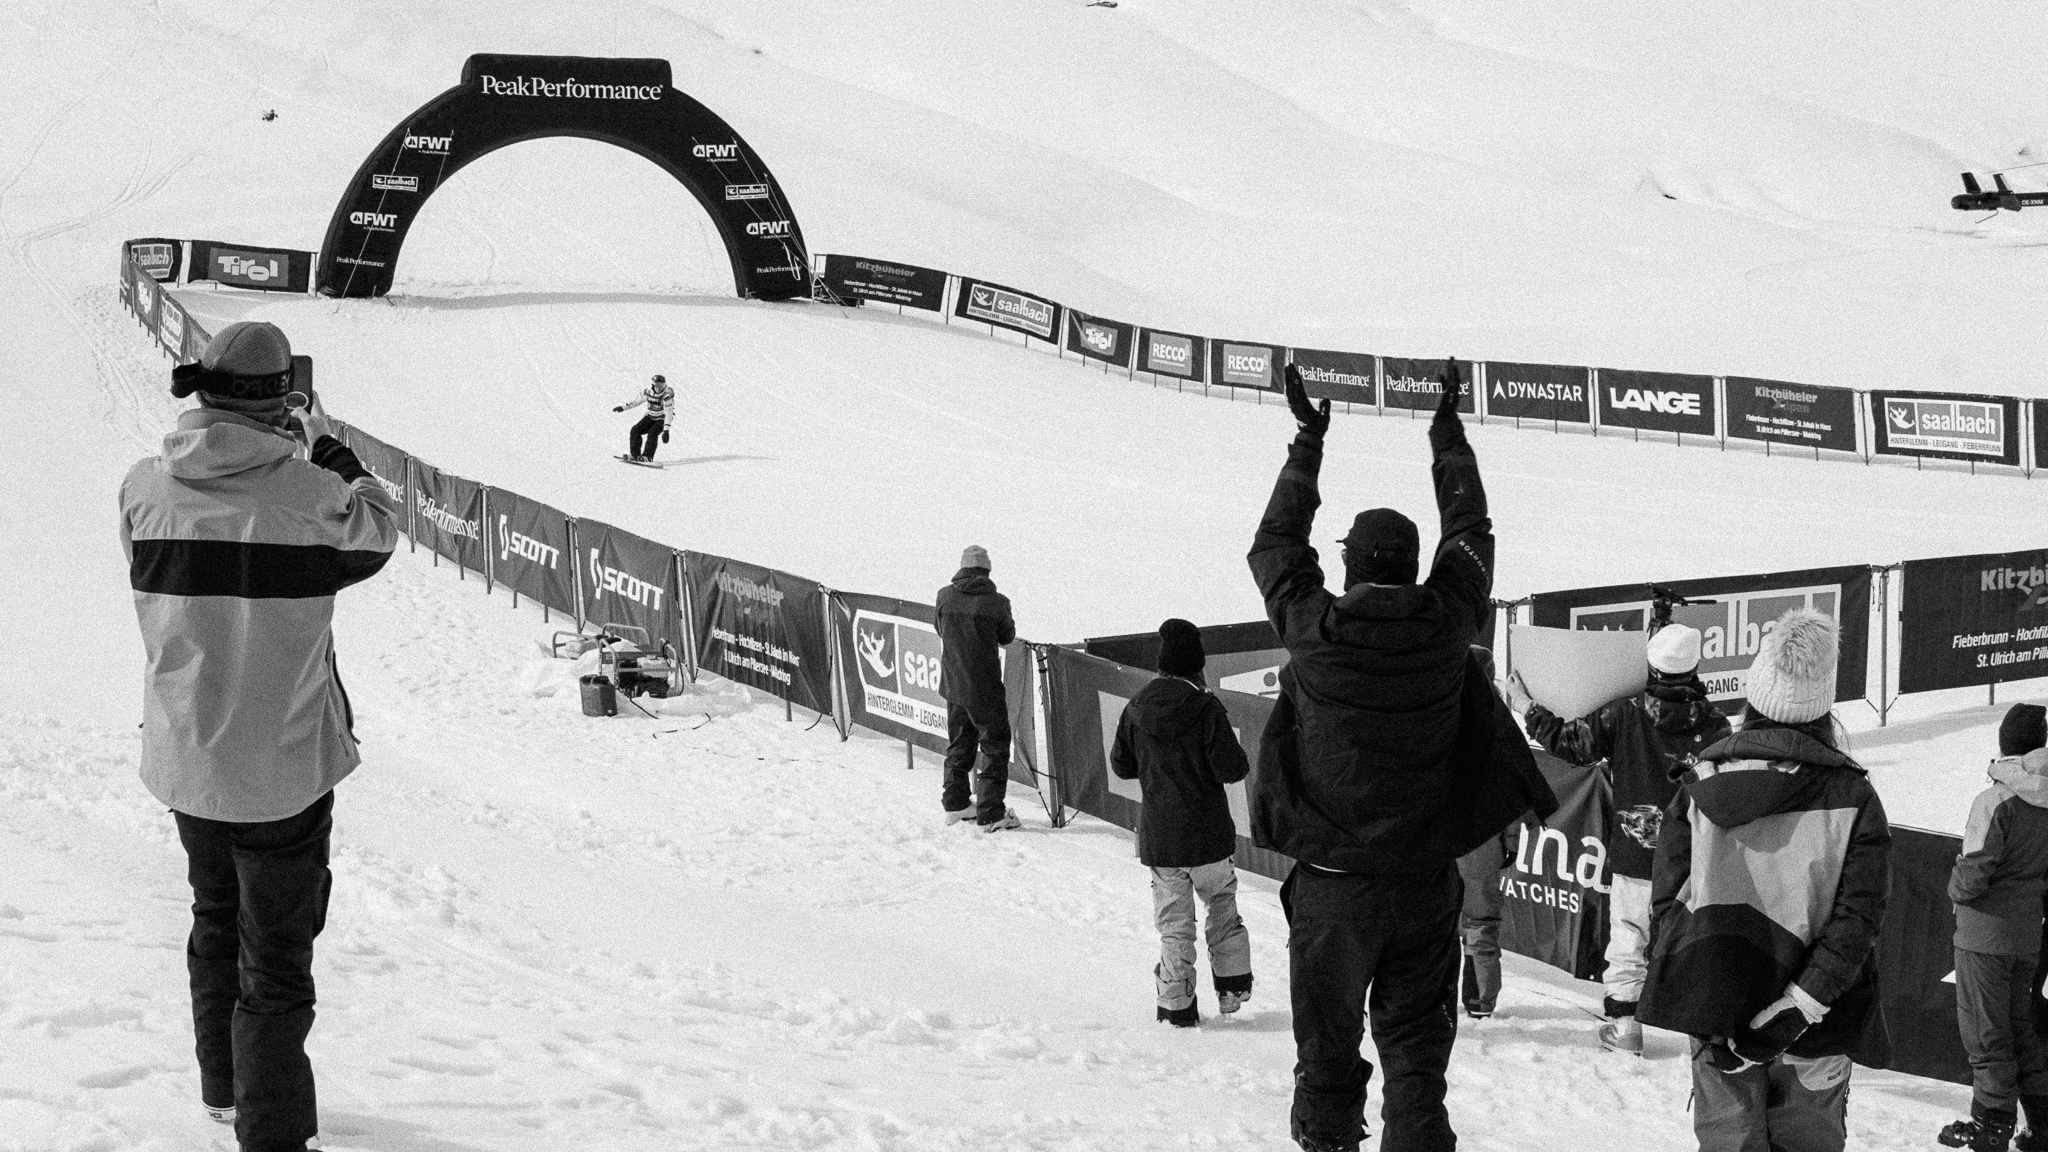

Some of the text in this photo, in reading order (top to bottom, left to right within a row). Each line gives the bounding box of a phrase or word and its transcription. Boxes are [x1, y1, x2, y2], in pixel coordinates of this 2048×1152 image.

[419, 136, 452, 150] FWT
[706, 145, 738, 158] FWT
[364, 212, 397, 227] FWT
[759, 221, 790, 234] FWT
[218, 255, 278, 281] Tirol
[997, 298, 1049, 324] saalbach
[1152, 343, 1185, 361] RECCO
[1228, 355, 1265, 372] RECCO
[1508, 381, 1582, 402] DYNASTAR
[1754, 386, 1818, 403] Kitzbüheler
[1610, 387, 1700, 416] LANGE
[1921, 404, 1996, 435] saalbach
[510, 531, 559, 569] SCOTT
[603, 566, 664, 611] SCOTT
[1952, 632, 2009, 649] Fieberbrunn
[1976, 653, 1989, 668] St.
[1990, 650, 2015, 667] Ulrich
[2016, 651, 2031, 662] am
[1706, 677, 1739, 695] GANG
[920, 705, 948, 732] LEOGAN
[1516, 822, 1612, 894] ina
